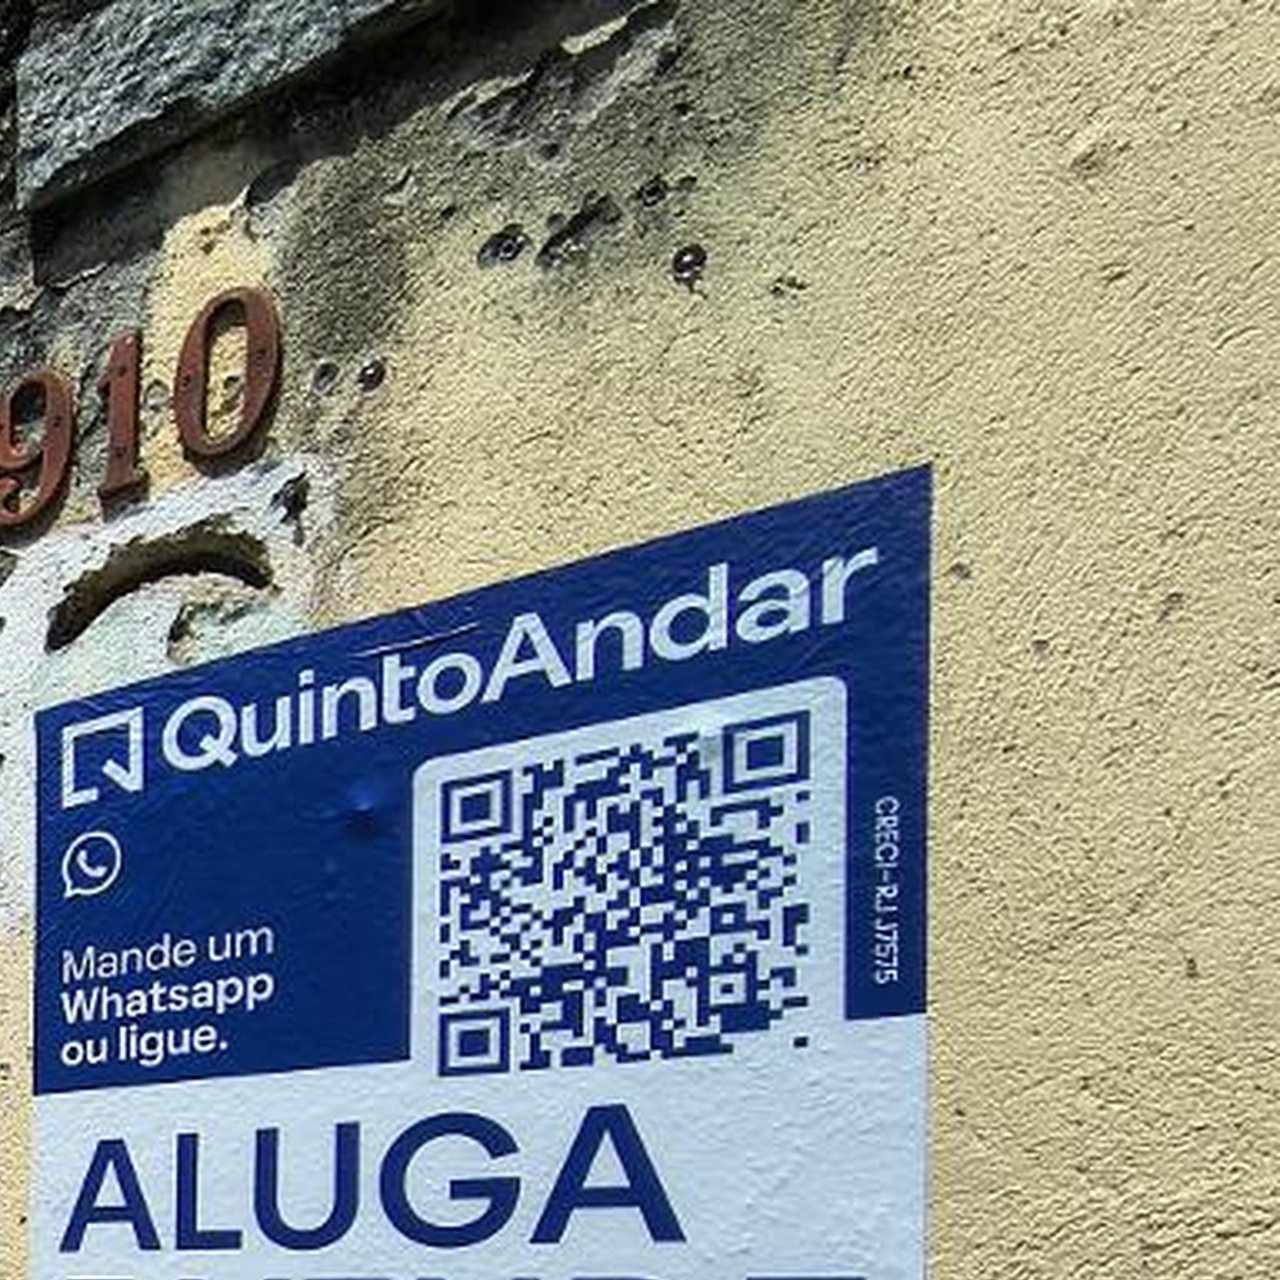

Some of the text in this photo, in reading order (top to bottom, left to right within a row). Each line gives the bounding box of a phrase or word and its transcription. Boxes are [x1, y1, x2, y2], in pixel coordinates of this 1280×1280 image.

[162, 547, 880, 773] QuintoAndar
[873, 795, 901, 913] CRECI-RJ
[59, 972, 275, 1026] Whatsapp
[61, 925, 275, 985] Mande um
[60, 1023, 229, 1067] ou ligue.
[59, 1102, 688, 1255] ALUGA
